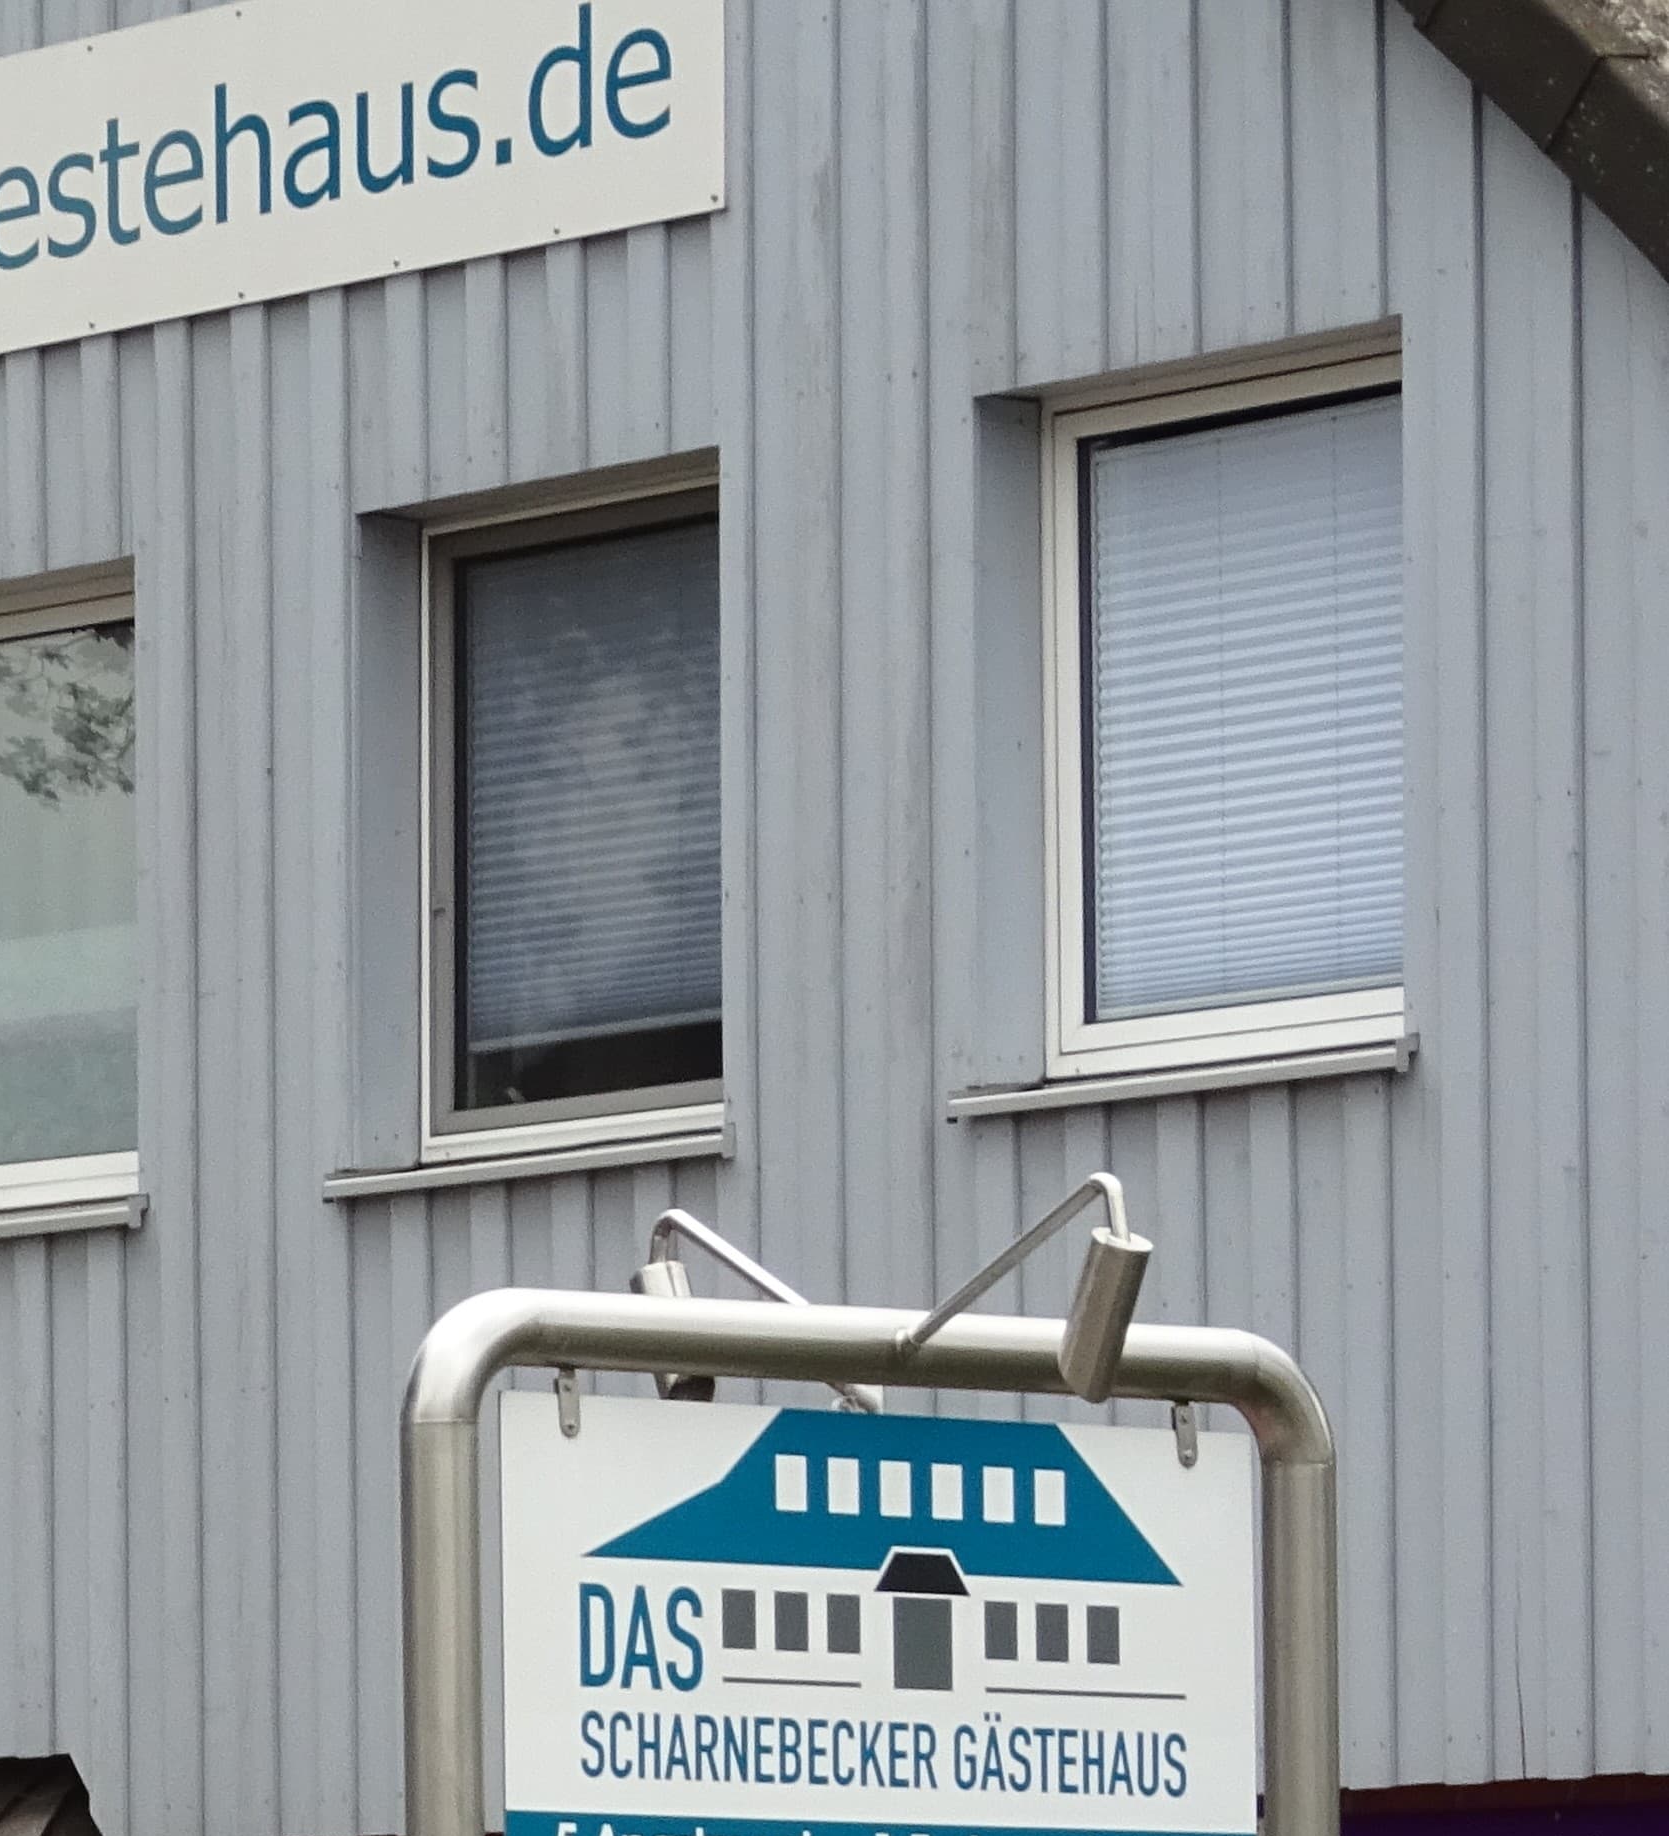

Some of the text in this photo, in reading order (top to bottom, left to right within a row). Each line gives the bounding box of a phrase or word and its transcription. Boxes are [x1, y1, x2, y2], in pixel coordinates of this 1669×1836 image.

[580, 1582, 704, 1691] DAS
[581, 1710, 1187, 1798] SCHARNEBECKER GÄSTEHAUS
